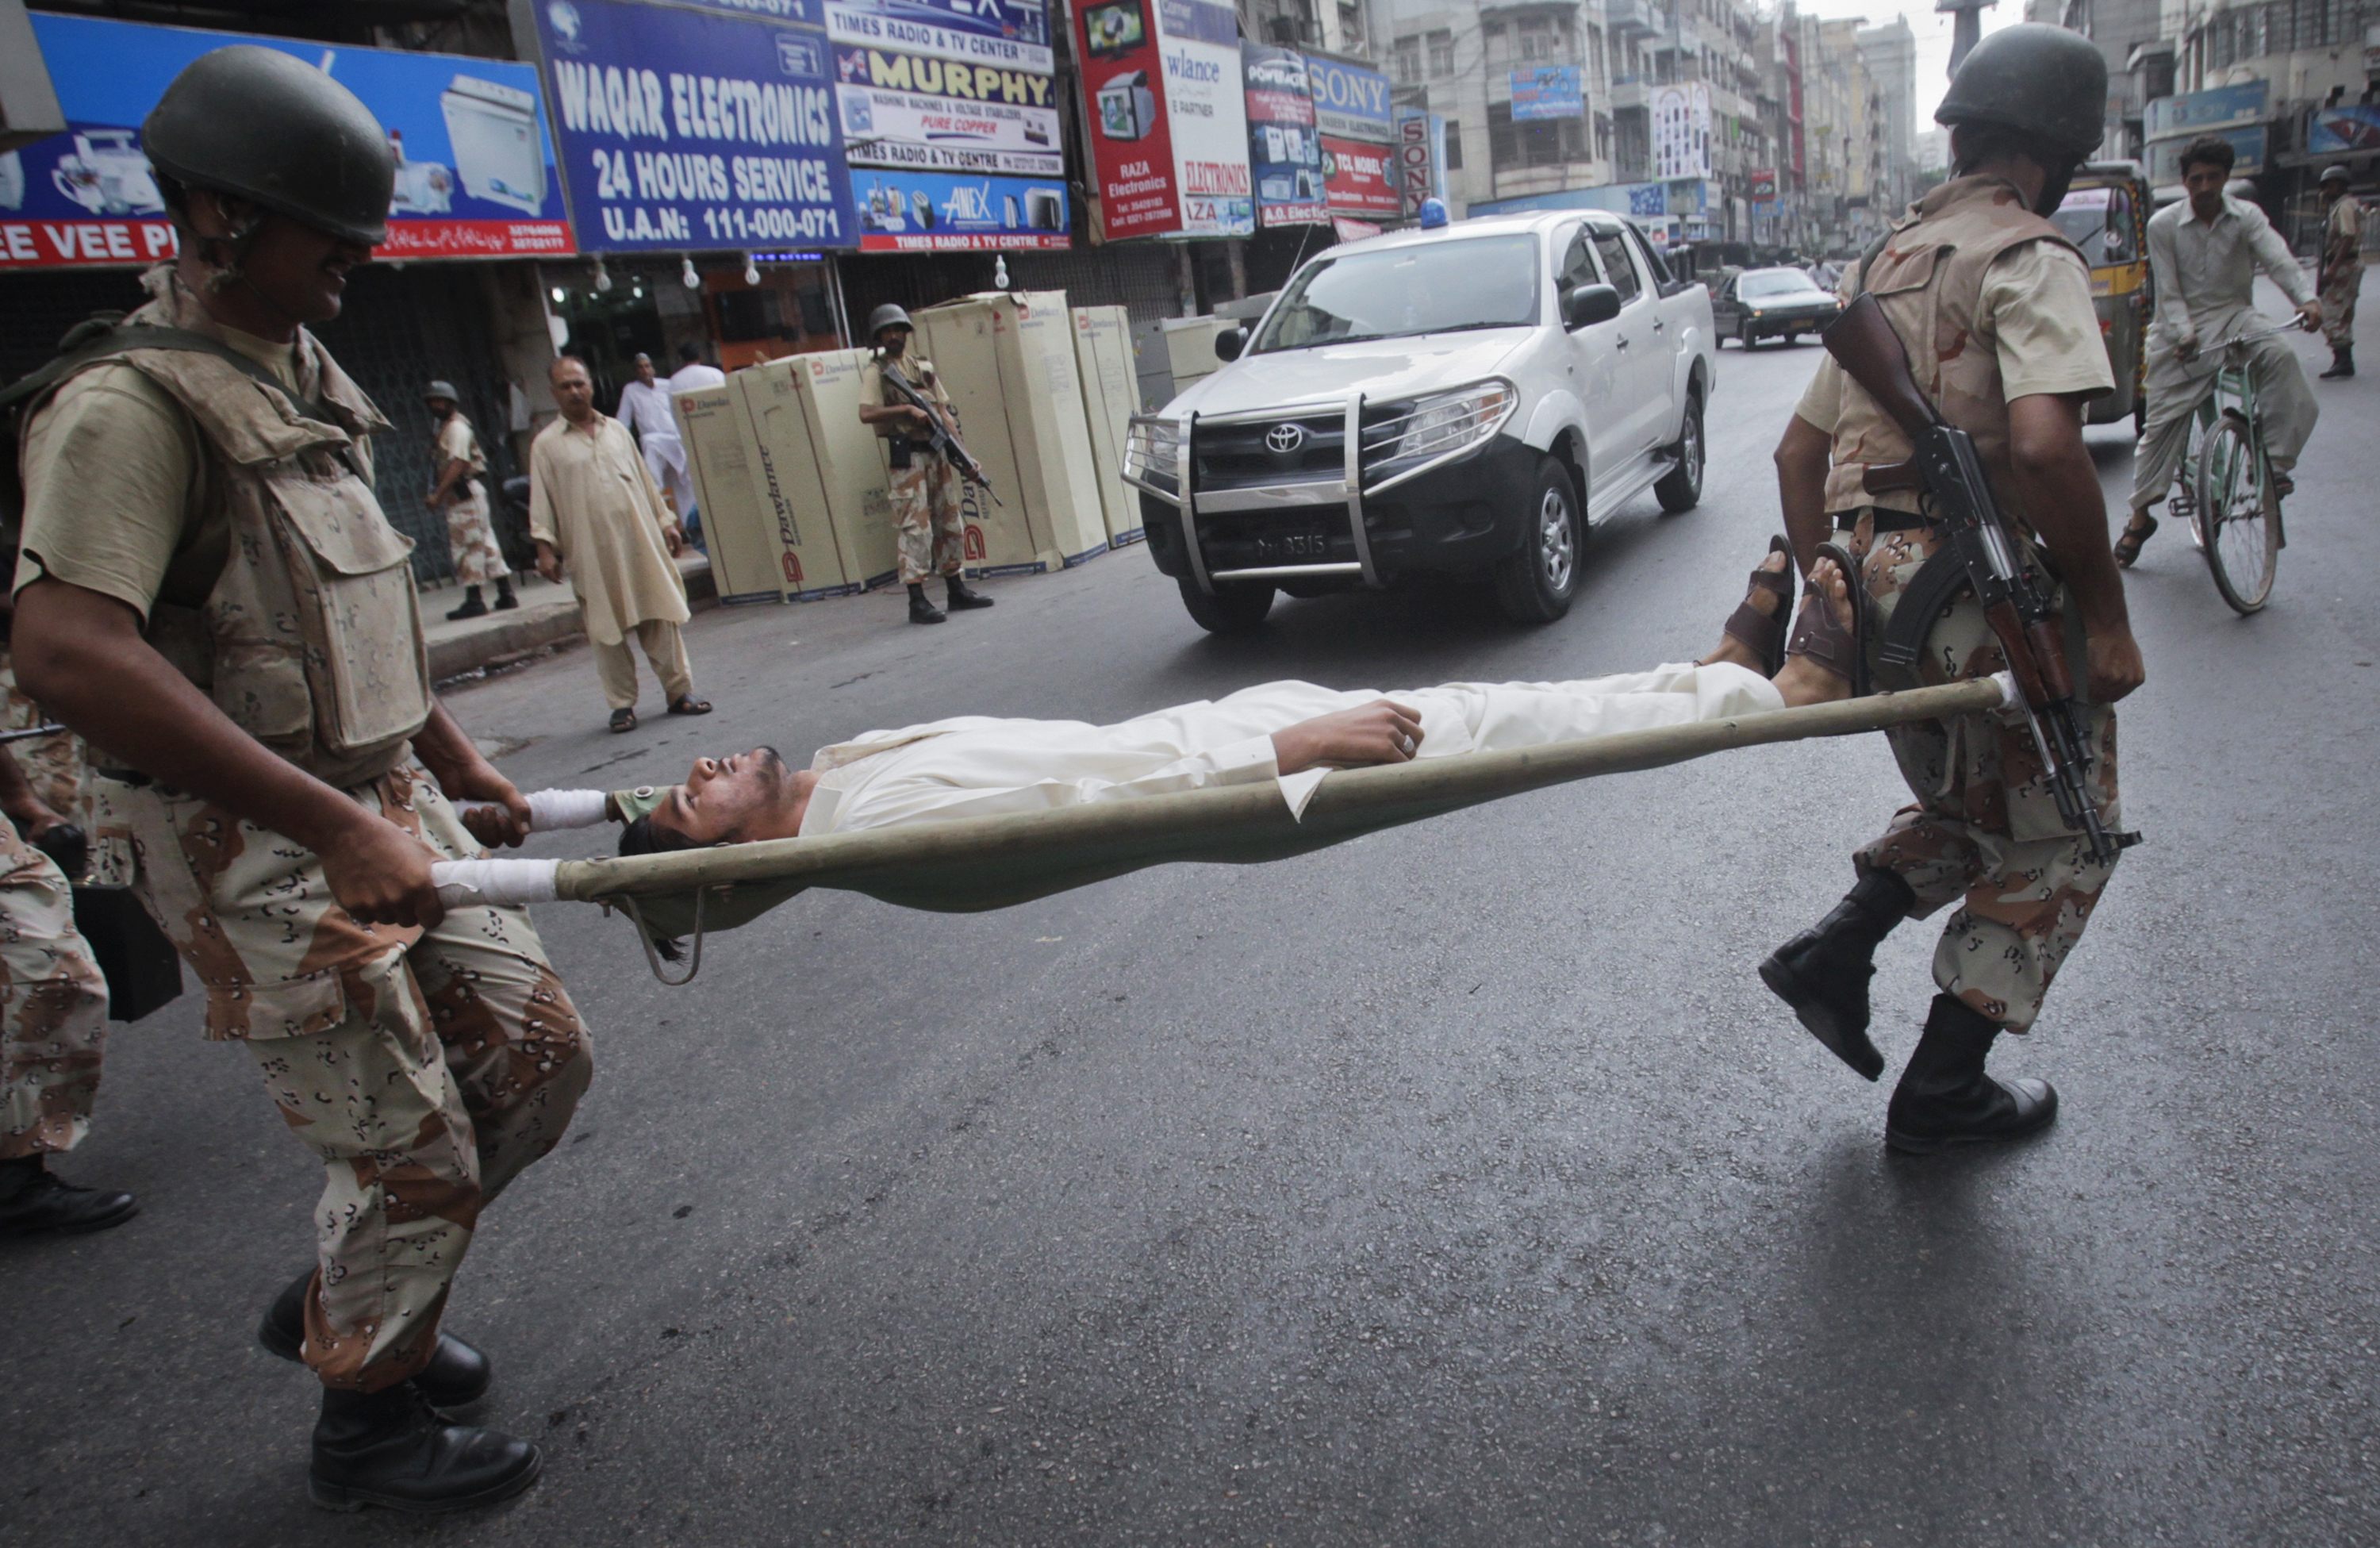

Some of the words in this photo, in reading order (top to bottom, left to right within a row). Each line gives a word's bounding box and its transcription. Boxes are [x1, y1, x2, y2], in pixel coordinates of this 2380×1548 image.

[833, 12, 881, 36] TIMES
[886, 21, 931, 45] RADIO
[935, 31, 946, 48] &
[950, 34, 966, 52] TV
[970, 38, 1019, 60] CENTER
[869, 50, 1049, 106] MURPHY
[1309, 63, 1385, 113] SONY
[553, 59, 669, 142] WAQAR
[669, 73, 831, 148] ELECTRONICS
[873, 94, 905, 108] WASHING
[1179, 100, 1214, 118] PARTNER
[921, 114, 951, 130] PURE
[954, 117, 997, 135] COPPER
[851, 143, 887, 160] TIMES
[890, 145, 927, 164] RADIO
[930, 150, 939, 165] &
[941, 150, 955, 166] TV
[958, 152, 999, 169] CENTRE
[1119, 160, 1150, 179] RAZA
[1402, 121, 1430, 213] SONY
[592, 148, 632, 199] 24
[634, 151, 730, 201] HOURS
[731, 156, 833, 202] SERVICE
[1107, 176, 1167, 198] Electronics
[1184, 160, 1250, 194] ELECTRONICS
[601, 206, 691, 241] U.A.N:
[703, 207, 840, 240] 111-000-071
[42, 224, 136, 259] VEE
[895, 235, 932, 249] TIMES
[935, 235, 970, 248] RADIO
[973, 236, 981, 248] &
[984, 235, 997, 248] TV
[1000, 235, 1039, 247] CENTRE
[759, 444, 796, 547] Dawlance
